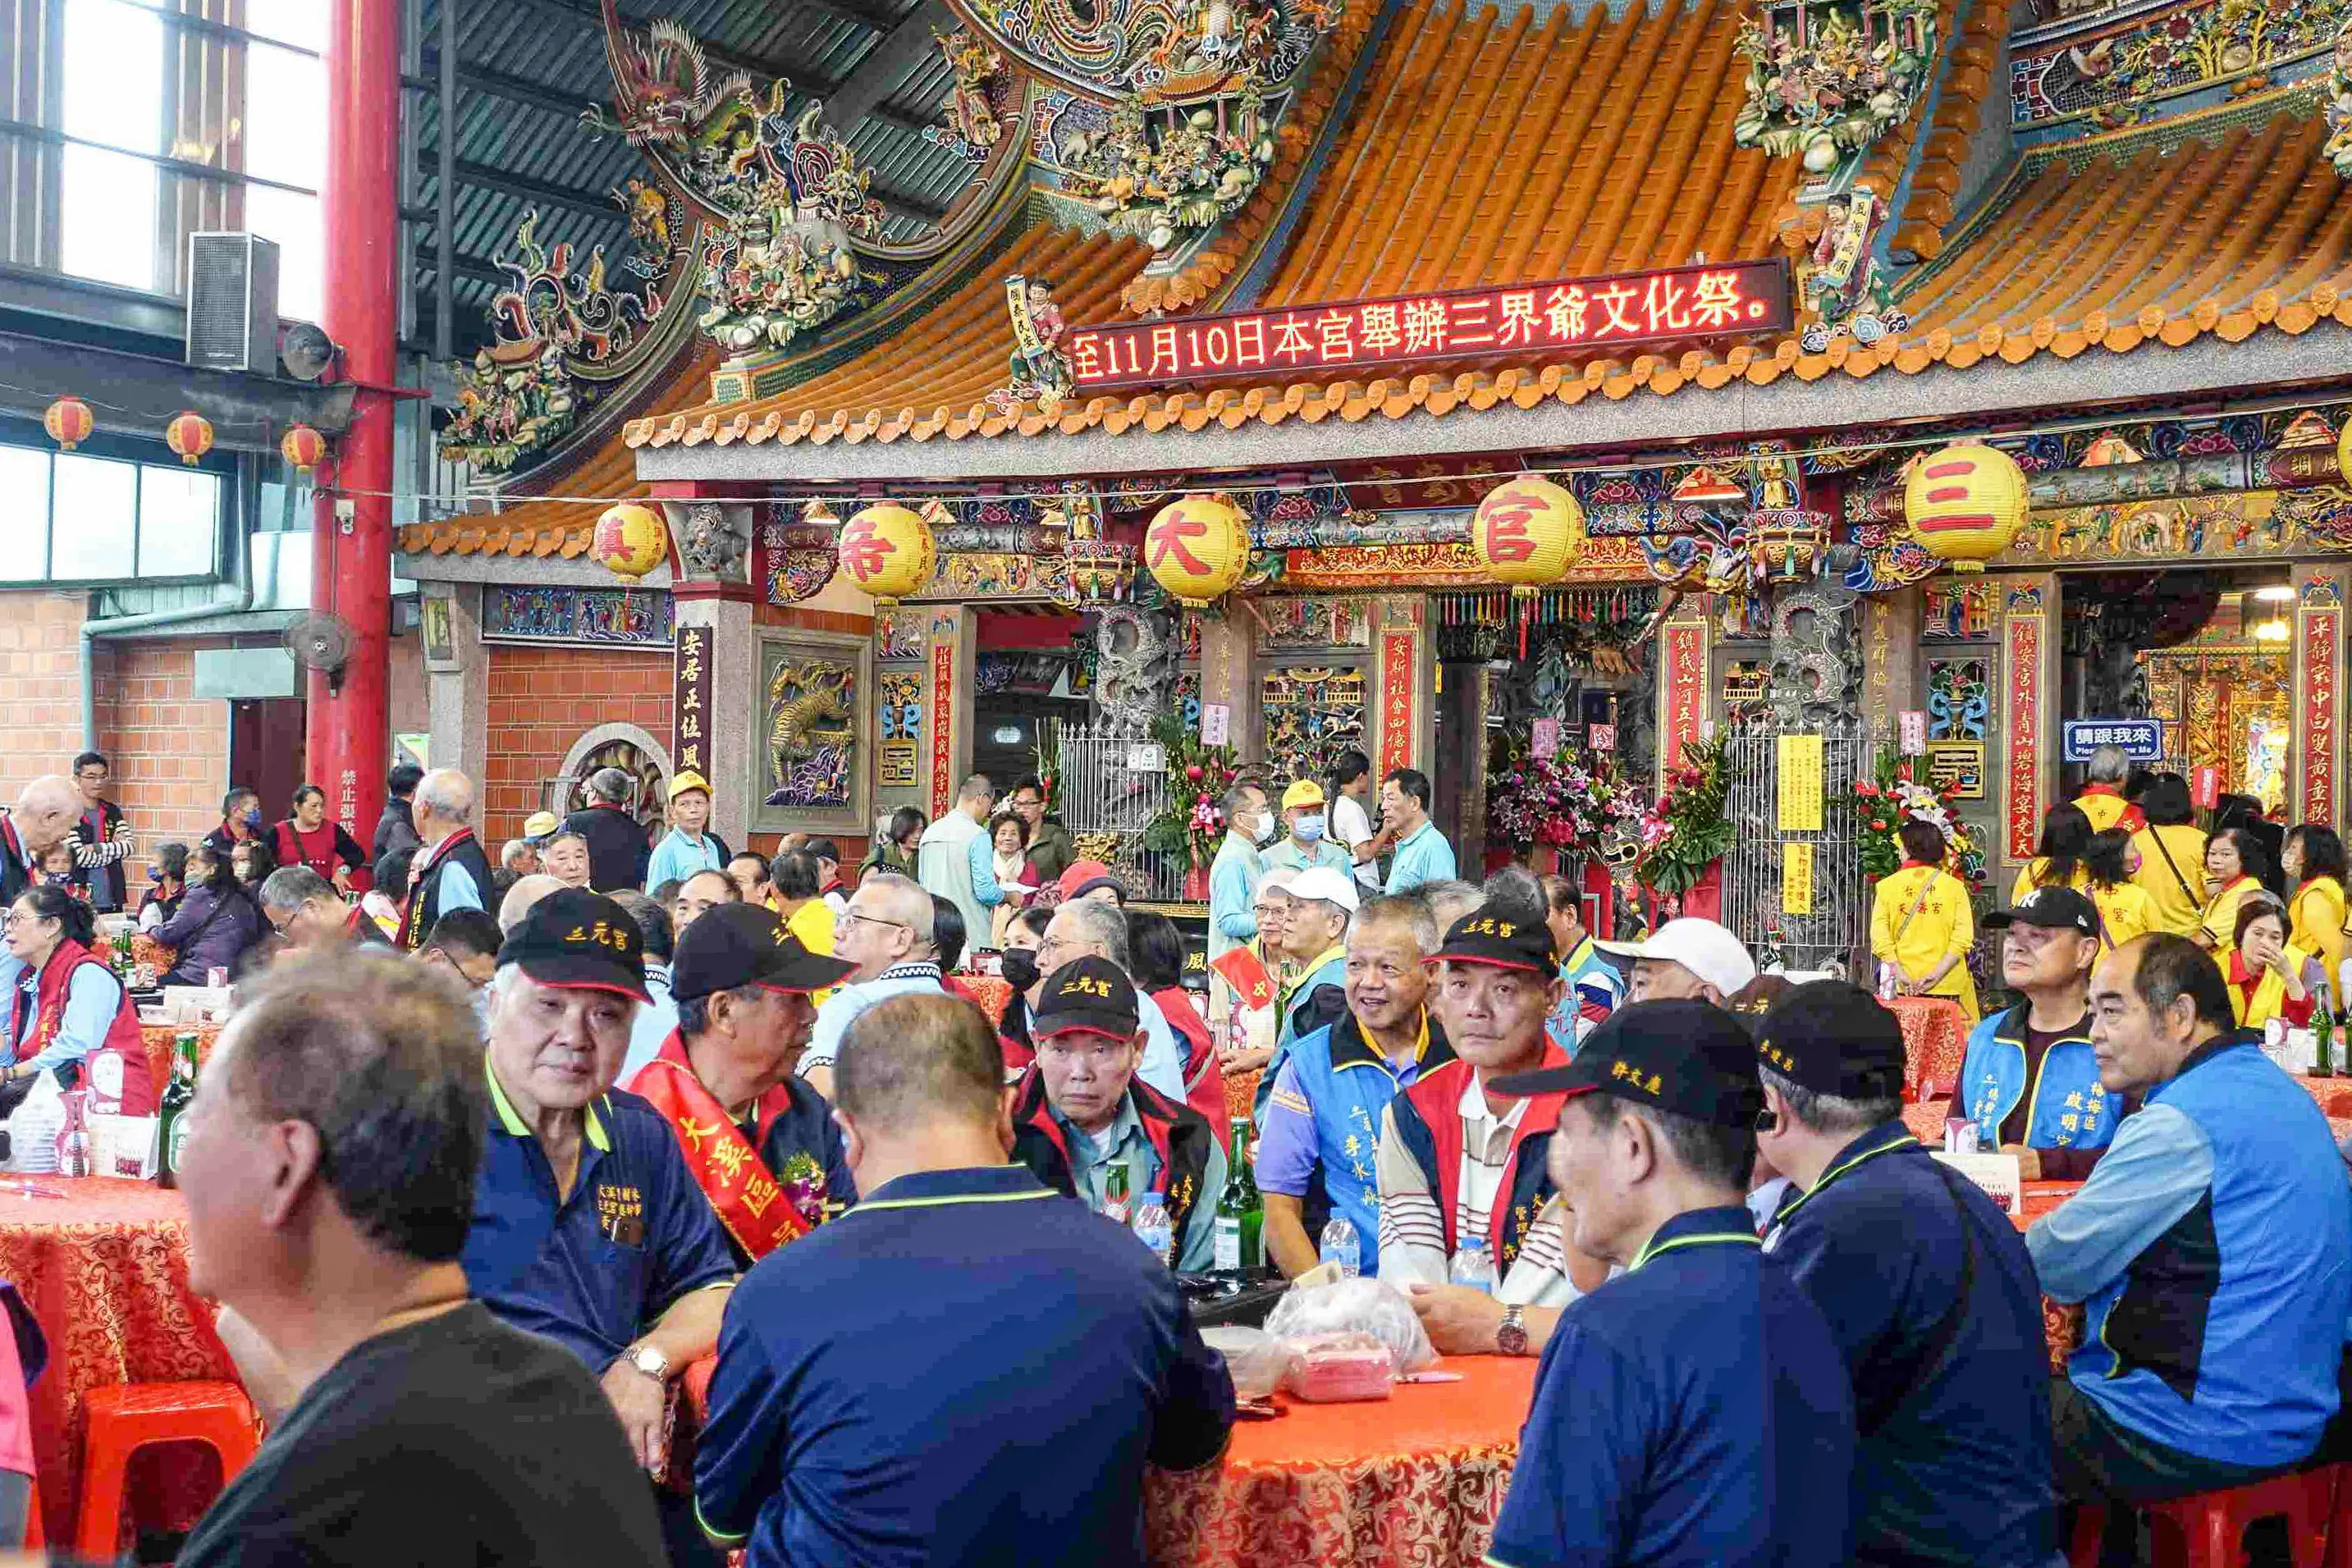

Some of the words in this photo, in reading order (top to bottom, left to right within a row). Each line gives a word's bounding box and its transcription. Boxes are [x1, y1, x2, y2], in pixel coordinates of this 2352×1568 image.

[1480, 491, 1550, 565] 官
[1915, 461, 1995, 532] 三
[839, 519, 897, 583] 帝
[1150, 510, 1213, 575] 大
[680, 629, 704, 770] 安居正位風
[1387, 635, 1407, 770] 安斯社會四億民
[2075, 727, 2153, 745] 請跟我來
[565, 921, 629, 952] 三元宮
[1058, 975, 1113, 999] 三元宮
